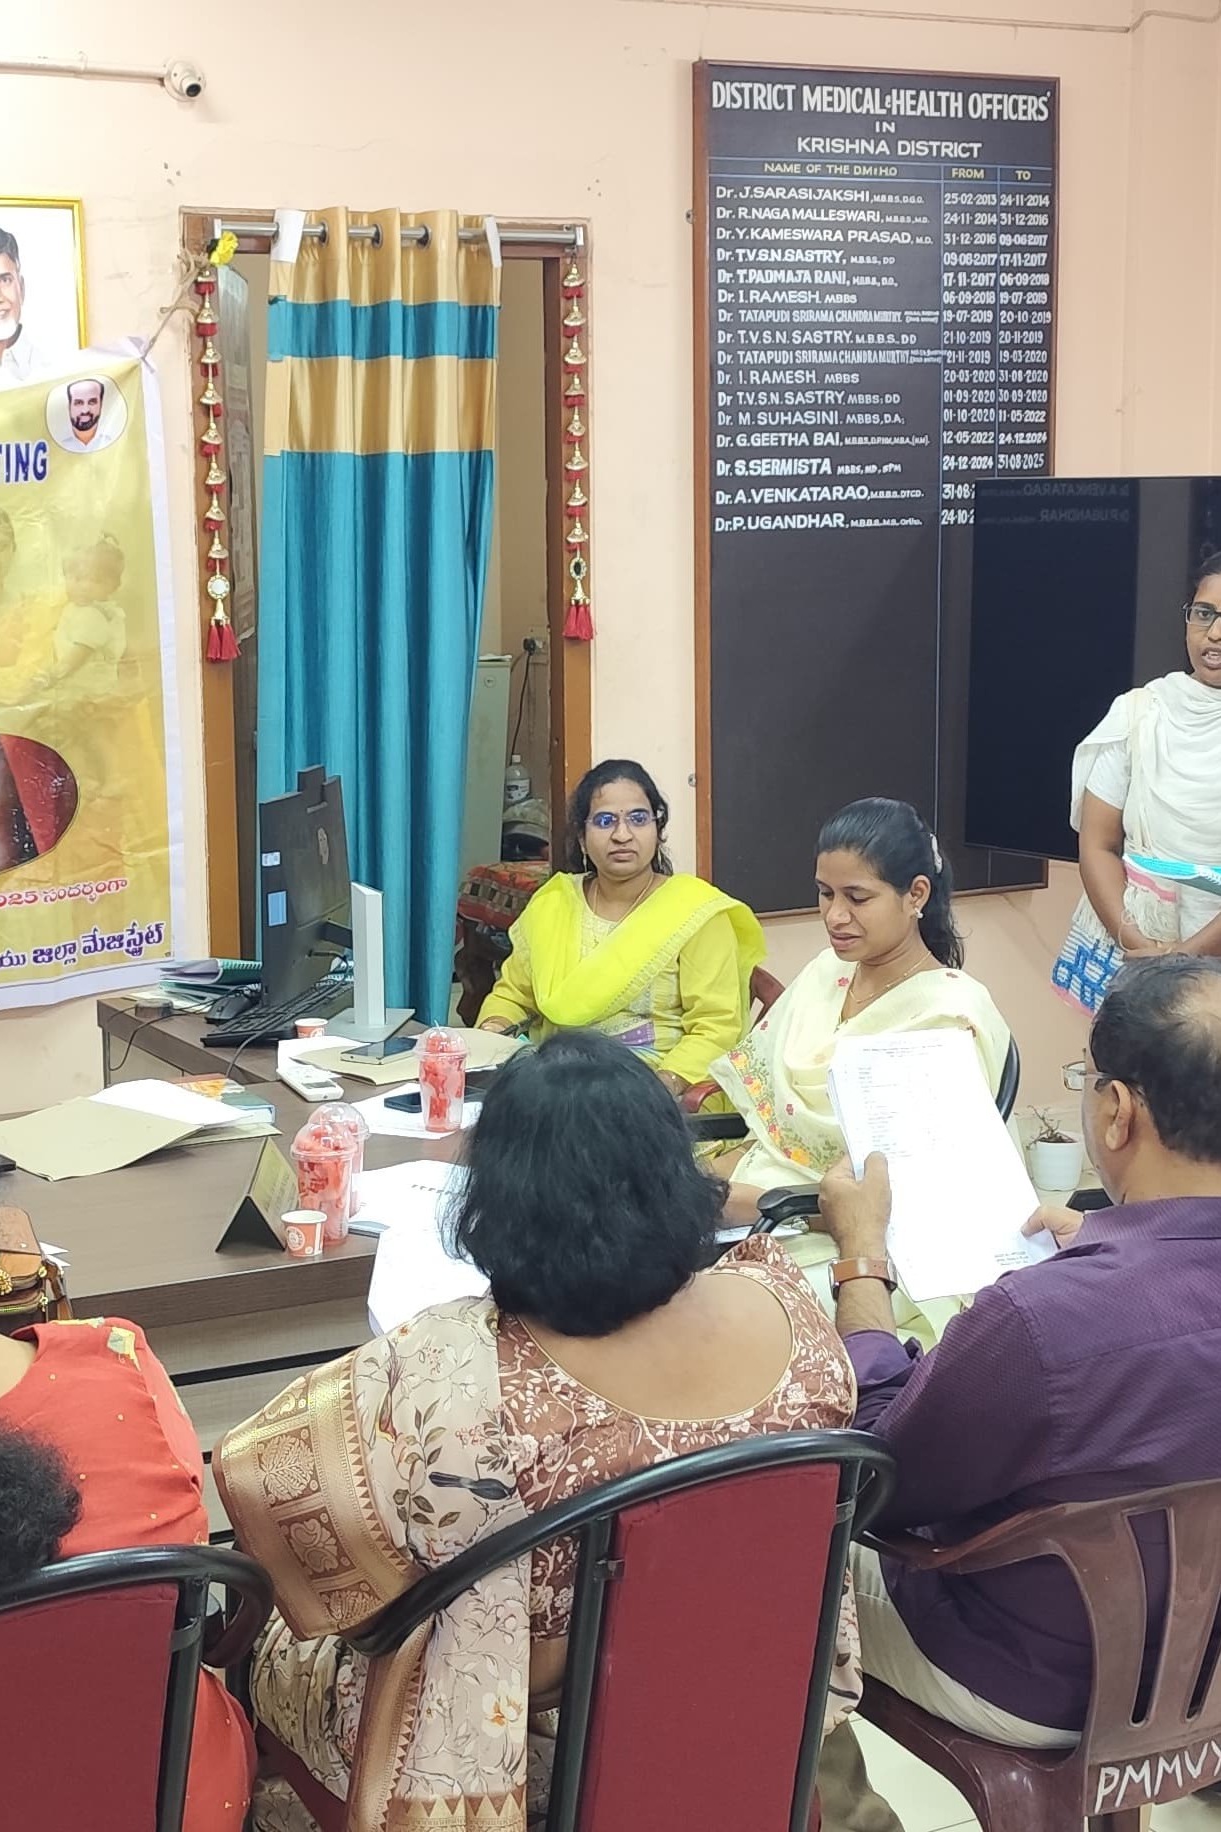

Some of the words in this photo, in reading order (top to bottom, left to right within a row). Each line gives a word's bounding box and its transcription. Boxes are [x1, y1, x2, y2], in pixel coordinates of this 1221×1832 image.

[712, 81, 796, 111] DISTRICT
[875, 121, 896, 133] IN
[797, 136, 890, 155] KRISHNA
[897, 140, 982, 159] DISTRICT
[764, 162, 801, 173] NAME
[806, 164, 821, 174] OF
[826, 165, 849, 175] THE
[952, 168, 985, 178] FROM
[1015, 170, 1031, 180] TO
[738, 309, 790, 322] TATAPUDI
[792, 310, 834, 322] SRIRAMA
[737, 351, 793, 364] TATAPUDI
[795, 351, 838, 364] SRIRAMA
[825, 373, 860, 383] MBBS
